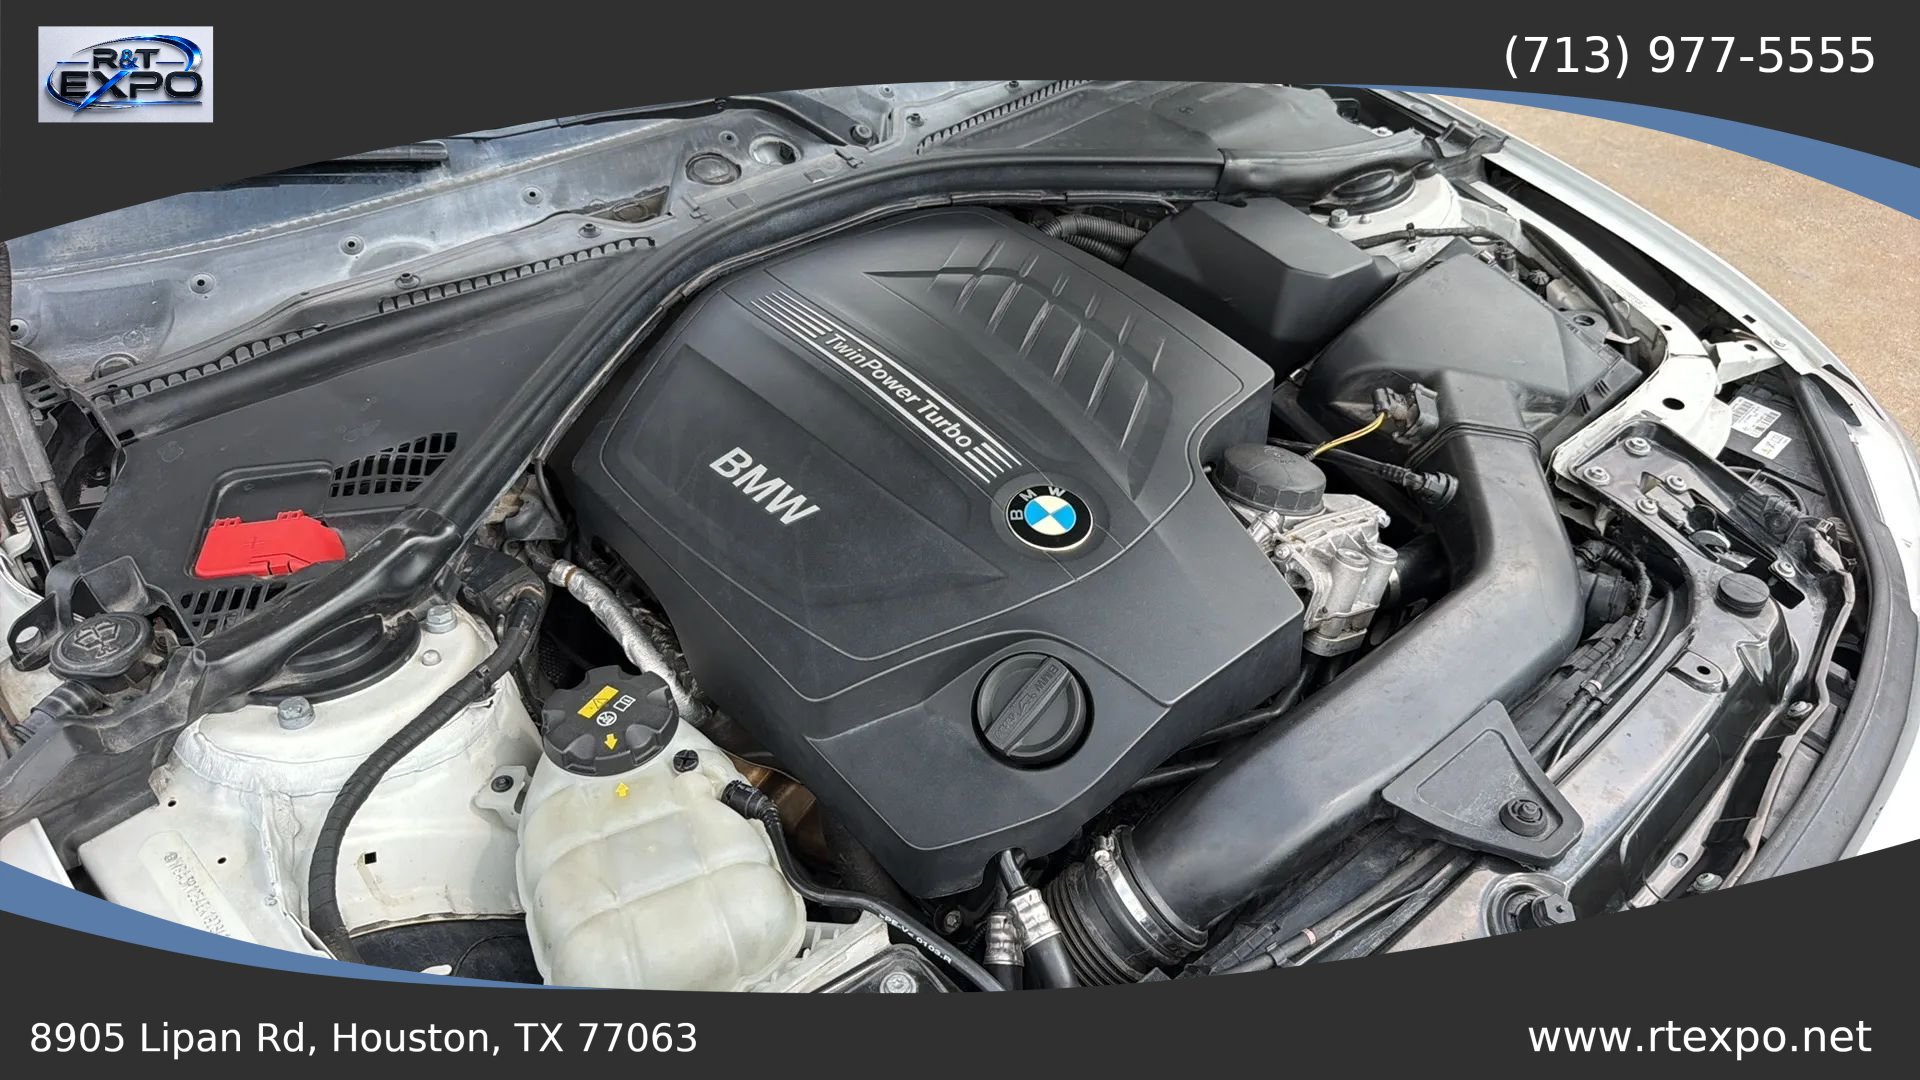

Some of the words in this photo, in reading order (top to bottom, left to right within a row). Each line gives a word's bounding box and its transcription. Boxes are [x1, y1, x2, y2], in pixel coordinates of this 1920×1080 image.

[825, 333, 921, 403] TwinPower
[917, 400, 972, 448] Turbo
[709, 446, 820, 524] BMW
[1009, 486, 1066, 521] BMW
